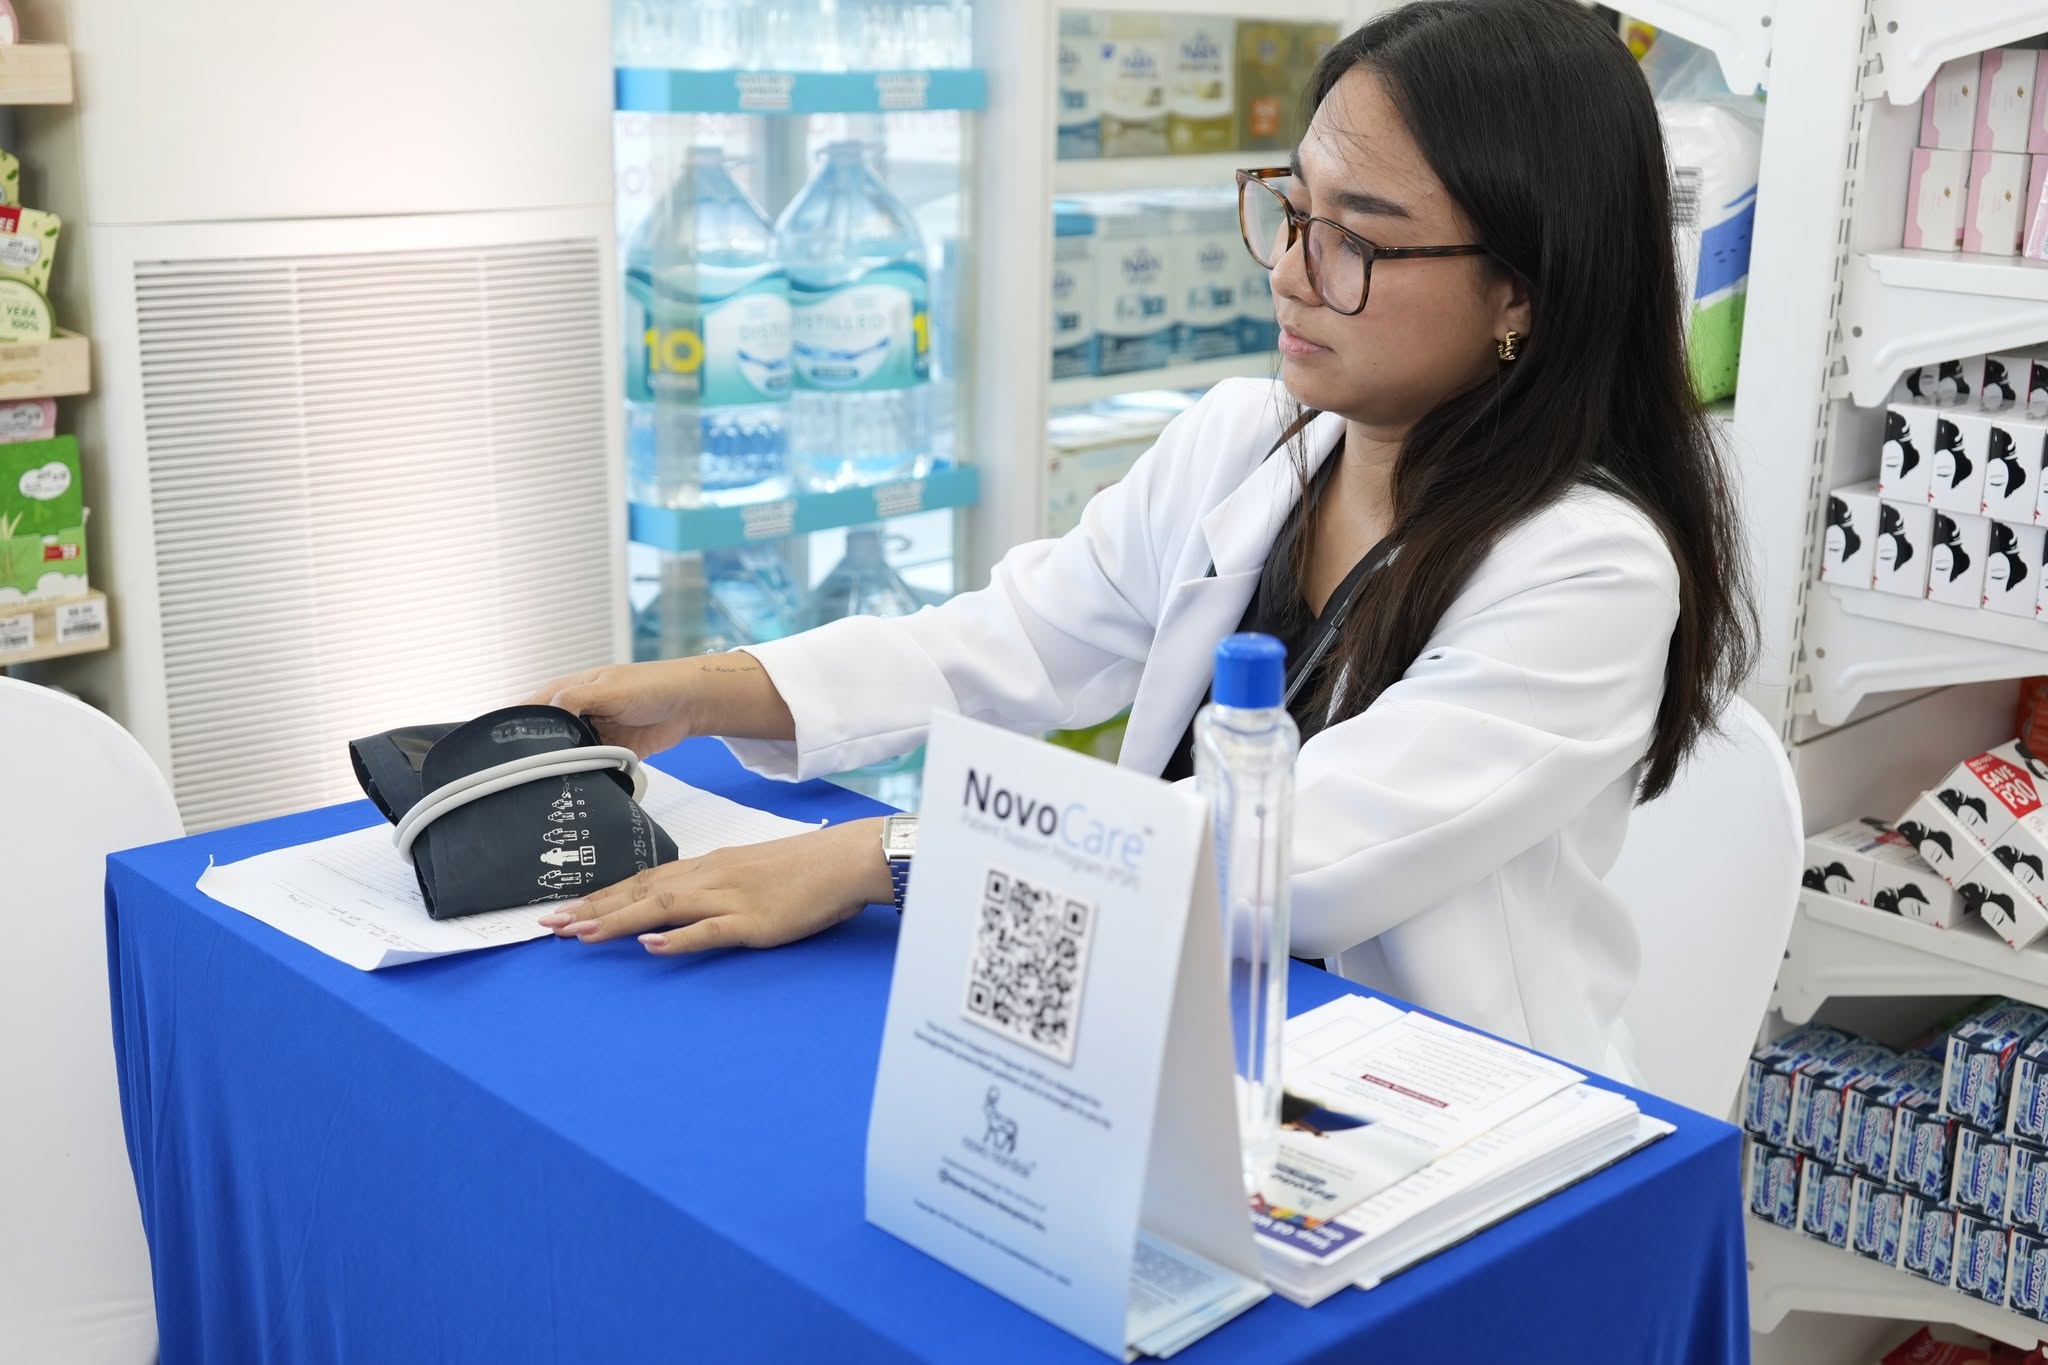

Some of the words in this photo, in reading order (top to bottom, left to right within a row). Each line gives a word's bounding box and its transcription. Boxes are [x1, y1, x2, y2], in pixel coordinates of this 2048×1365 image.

[7, 305, 37, 317] VERA
[11, 319, 39, 331] 100%
[644, 328, 705, 374] 10
[1982, 765, 2015, 788] SAVE
[578, 811, 587, 819] 9
[582, 829, 590, 840] 10
[582, 849, 593, 862] 11
[585, 871, 594, 884] 12
[1965, 1058, 1981, 1112] Bioderm
[2033, 1077, 2048, 1132] Bioderm
[1974, 1150, 1992, 1200] Bioderm
[2029, 1167, 2046, 1219] Bioderm
[1972, 1235, 1990, 1288] Bioderm
[2028, 1253, 2046, 1307] Bioderm
